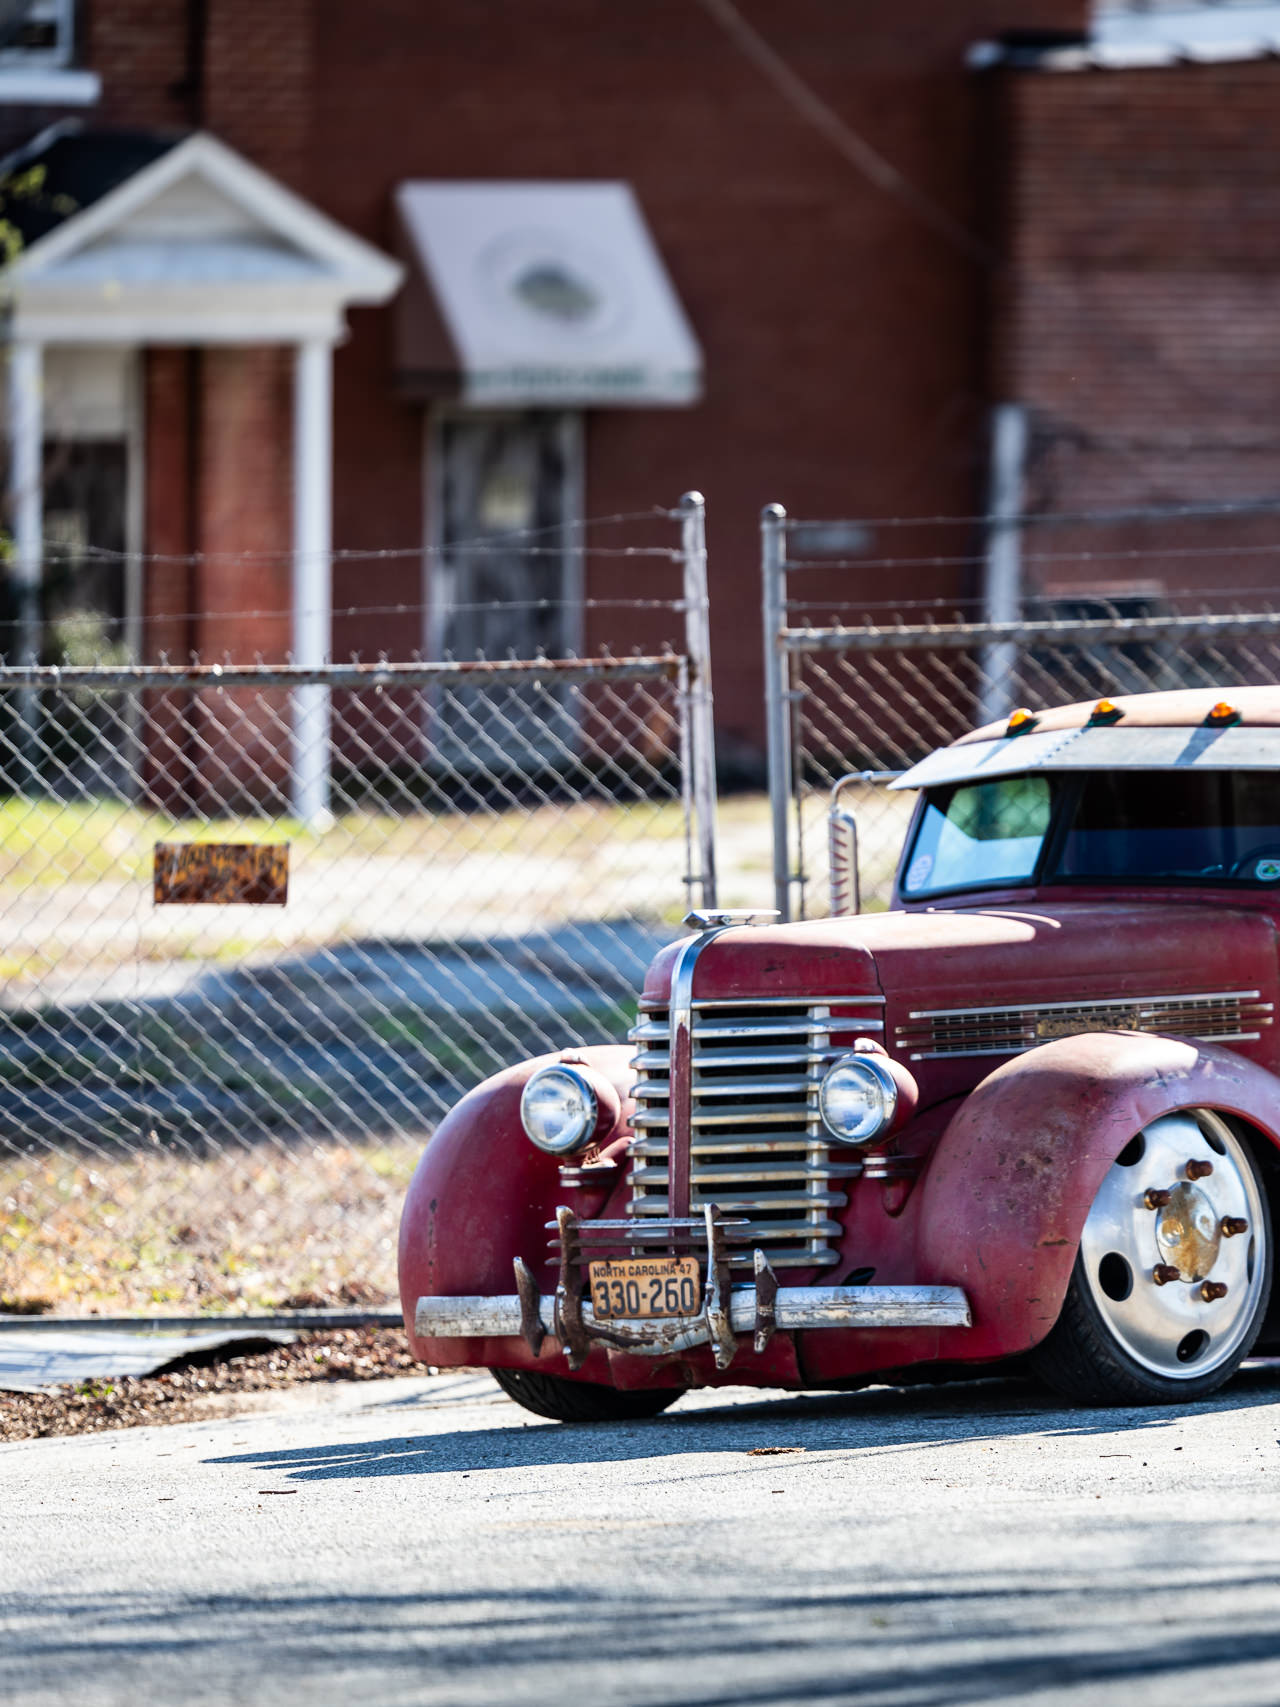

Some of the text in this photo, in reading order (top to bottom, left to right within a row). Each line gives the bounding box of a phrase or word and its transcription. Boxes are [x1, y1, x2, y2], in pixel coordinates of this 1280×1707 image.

[593, 1265, 625, 1278] NORTH
[628, 1263, 676, 1276] CAROLINA
[595, 1277, 694, 1315] 330-260
